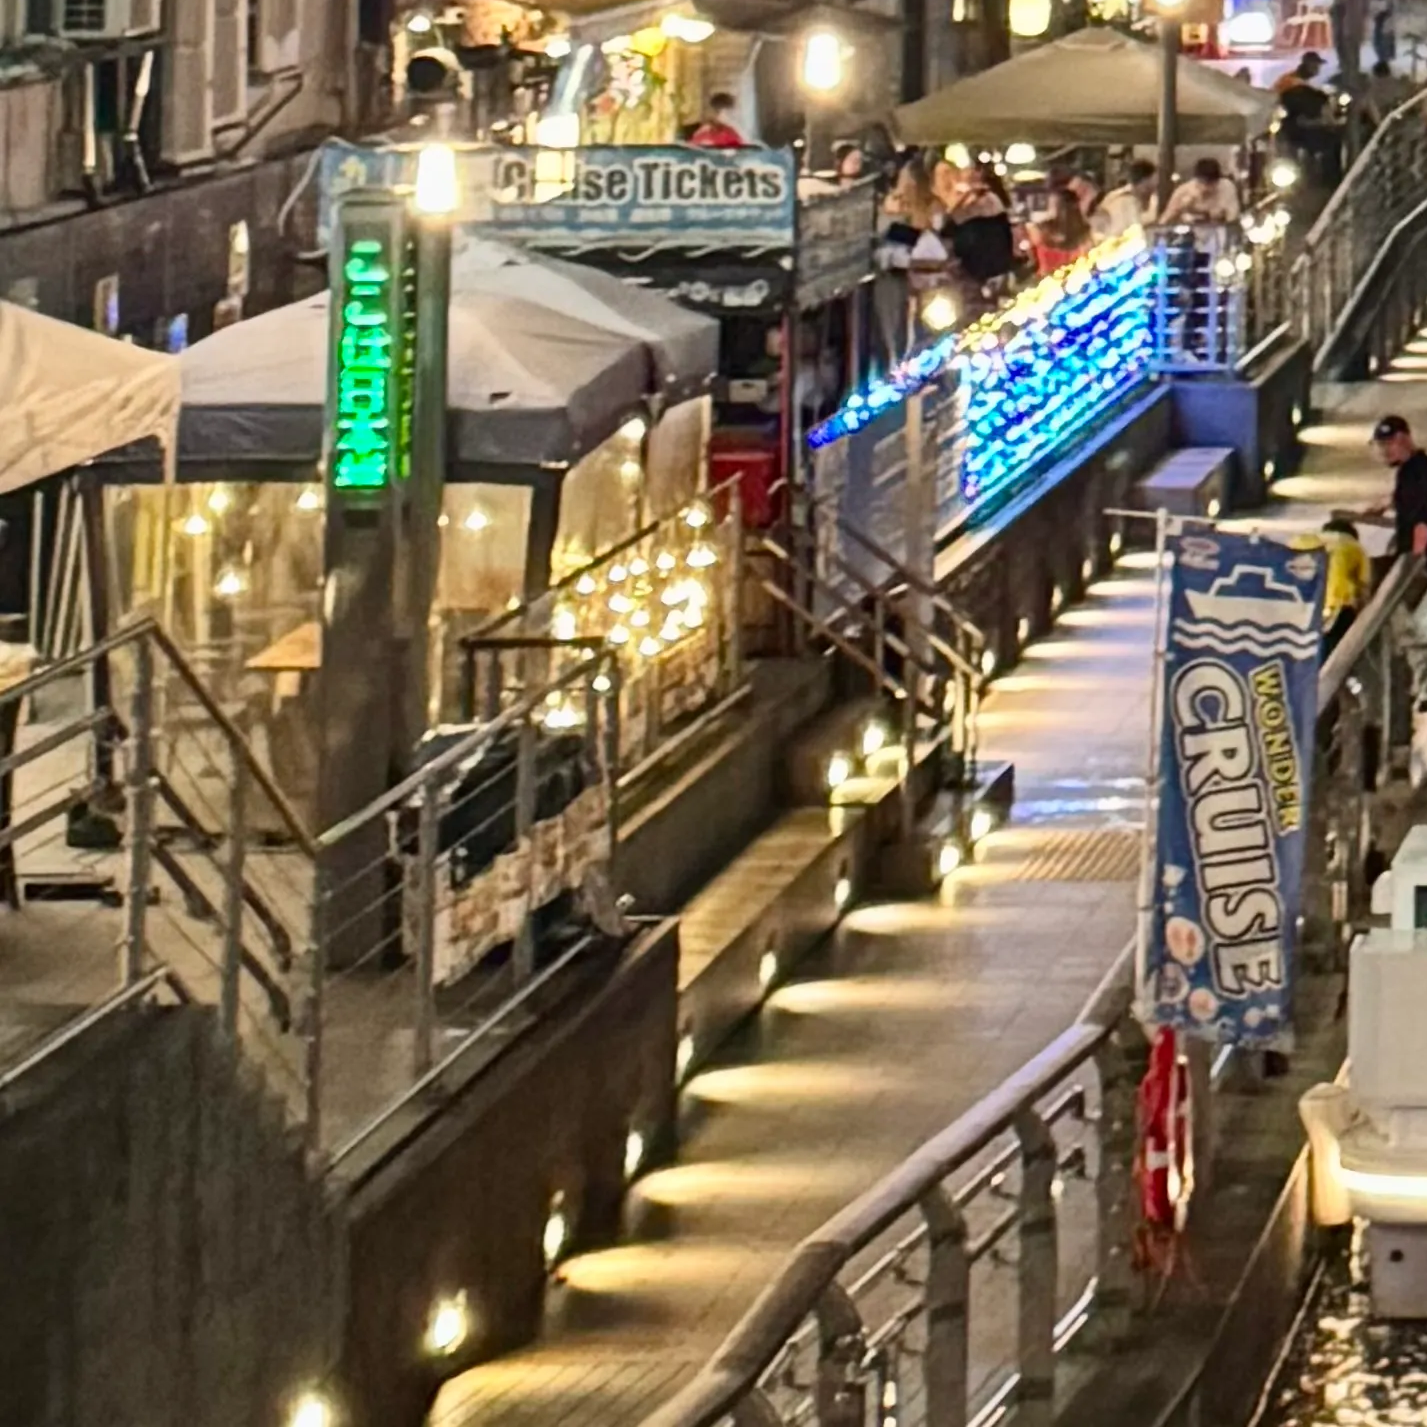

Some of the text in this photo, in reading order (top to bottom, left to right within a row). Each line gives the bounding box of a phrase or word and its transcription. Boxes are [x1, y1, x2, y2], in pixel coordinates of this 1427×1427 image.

[637, 159, 782, 202] Tickets
[1171, 658, 1284, 997] CRUISE
[1252, 662, 1300, 834] WONDER
